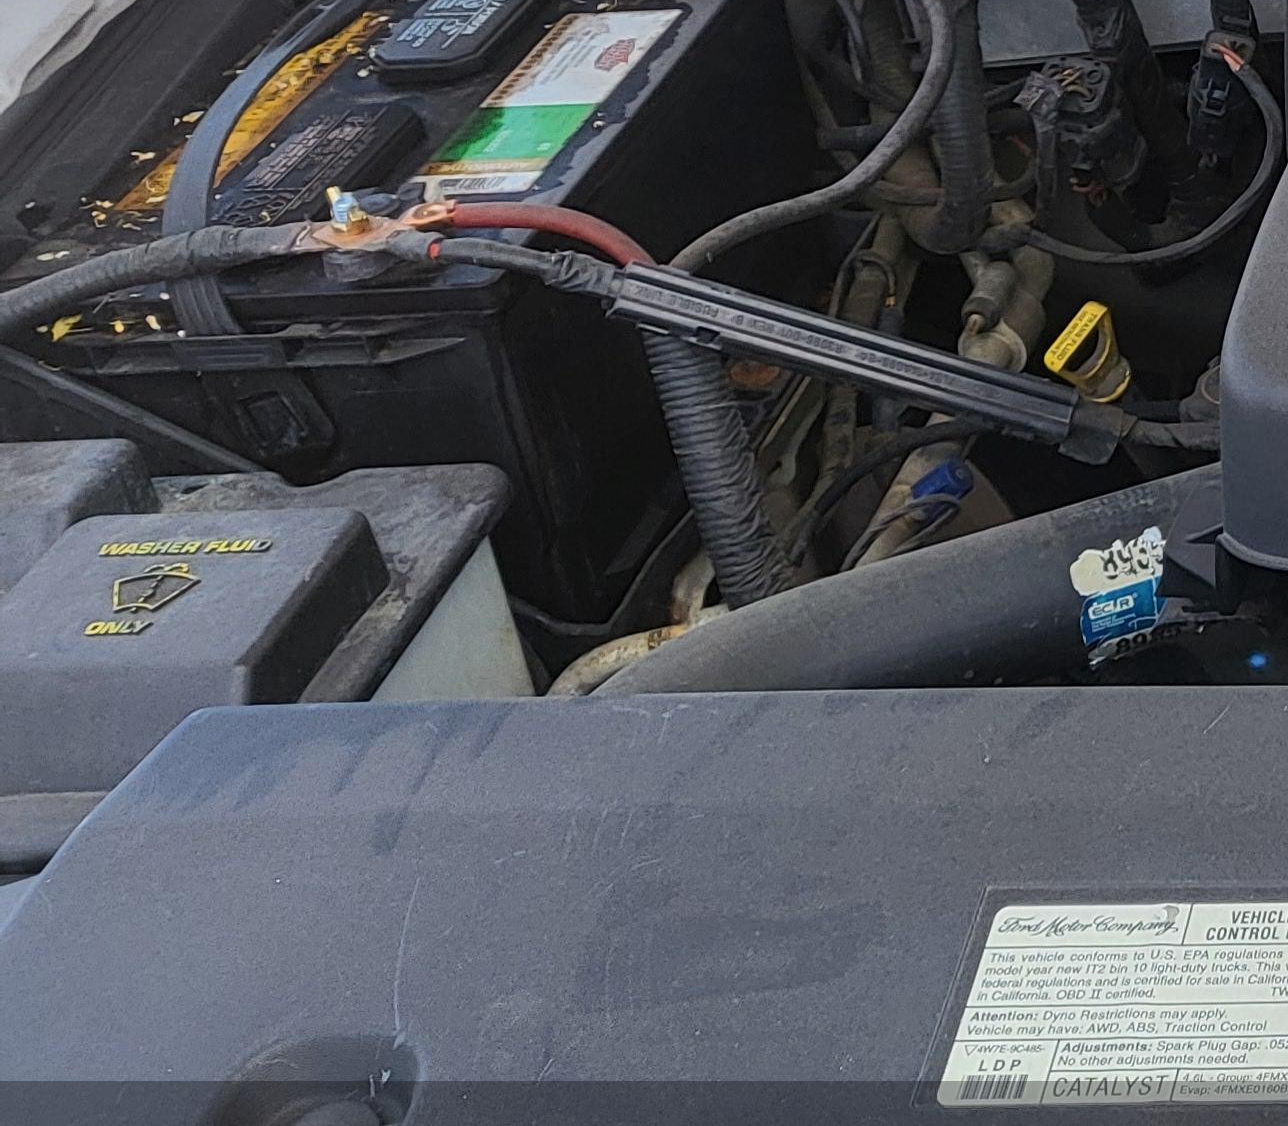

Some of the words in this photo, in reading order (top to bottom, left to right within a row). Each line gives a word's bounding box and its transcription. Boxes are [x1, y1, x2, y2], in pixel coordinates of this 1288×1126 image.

[99, 541, 201, 557] WASHER
[203, 538, 274, 553] FLUID
[84, 621, 154, 636] ONLY
[998, 916, 1044, 934] Ford
[1033, 916, 1092, 937] Motor
[1093, 916, 1179, 936] Company
[1206, 927, 1279, 941] CONTROL
[990, 953, 1015, 963] This
[1021, 952, 1064, 962] vehicle
[1070, 951, 1127, 962] conforms
[1133, 951, 1145, 961] to
[1150, 950, 1176, 960] U.S.
[1183, 950, 1209, 960] EPA
[1214, 949, 1283, 962] regulations
[985, 965, 1022, 975] model
[1026, 965, 1052, 977] year
[1056, 965, 1081, 973] new
[1109, 963, 1128, 973] bin
[1133, 963, 1147, 972] 10
[1150, 962, 1208, 975] light-duty
[1211, 962, 1251, 972] trucks.
[1257, 961, 1281, 971] This
[981, 977, 1022, 988] federal
[1025, 976, 1092, 989] regulations
[1095, 976, 1118, 986] and
[1121, 976, 1131, 986] is
[1134, 975, 1183, 985] certified
[1186, 974, 1201, 985] for
[1205, 975, 1230, 985] sale
[1233, 975, 1244, 984] in
[977, 991, 988, 1001] in
[991, 989, 1051, 1001] California.
[1056, 989, 1086, 1000] OBD
[1106, 988, 1156, 999] certified.
[970, 1010, 1039, 1022] Attention:
[1042, 1009, 1076, 1022] Dyno
[1080, 1008, 1156, 1020] Restrictions
[1159, 1010, 1187, 1021] may
[1190, 1008, 1228, 1020] apply.
[967, 1025, 1013, 1036] Vehicle
[1017, 1026, 1047, 1037] may
[1049, 1024, 1084, 1035] have:
[1086, 1023, 1123, 1035] AWD,
[1126, 1023, 1159, 1034] ABS,
[1164, 1022, 1215, 1033] Traction
[1220, 1021, 1267, 1032] Control
[1062, 1042, 1152, 1054] Adjustments:
[1156, 1041, 1195, 1052] Spark
[1198, 1041, 1226, 1052] Plug
[1231, 1040, 1262, 1051] Gap:
[1057, 1056, 1076, 1066] No
[1080, 1056, 1112, 1066] other
[1116, 1055, 1194, 1067] adjustments
[1198, 1053, 1249, 1064] needed.
[1052, 1074, 1169, 1097] CATALYST
